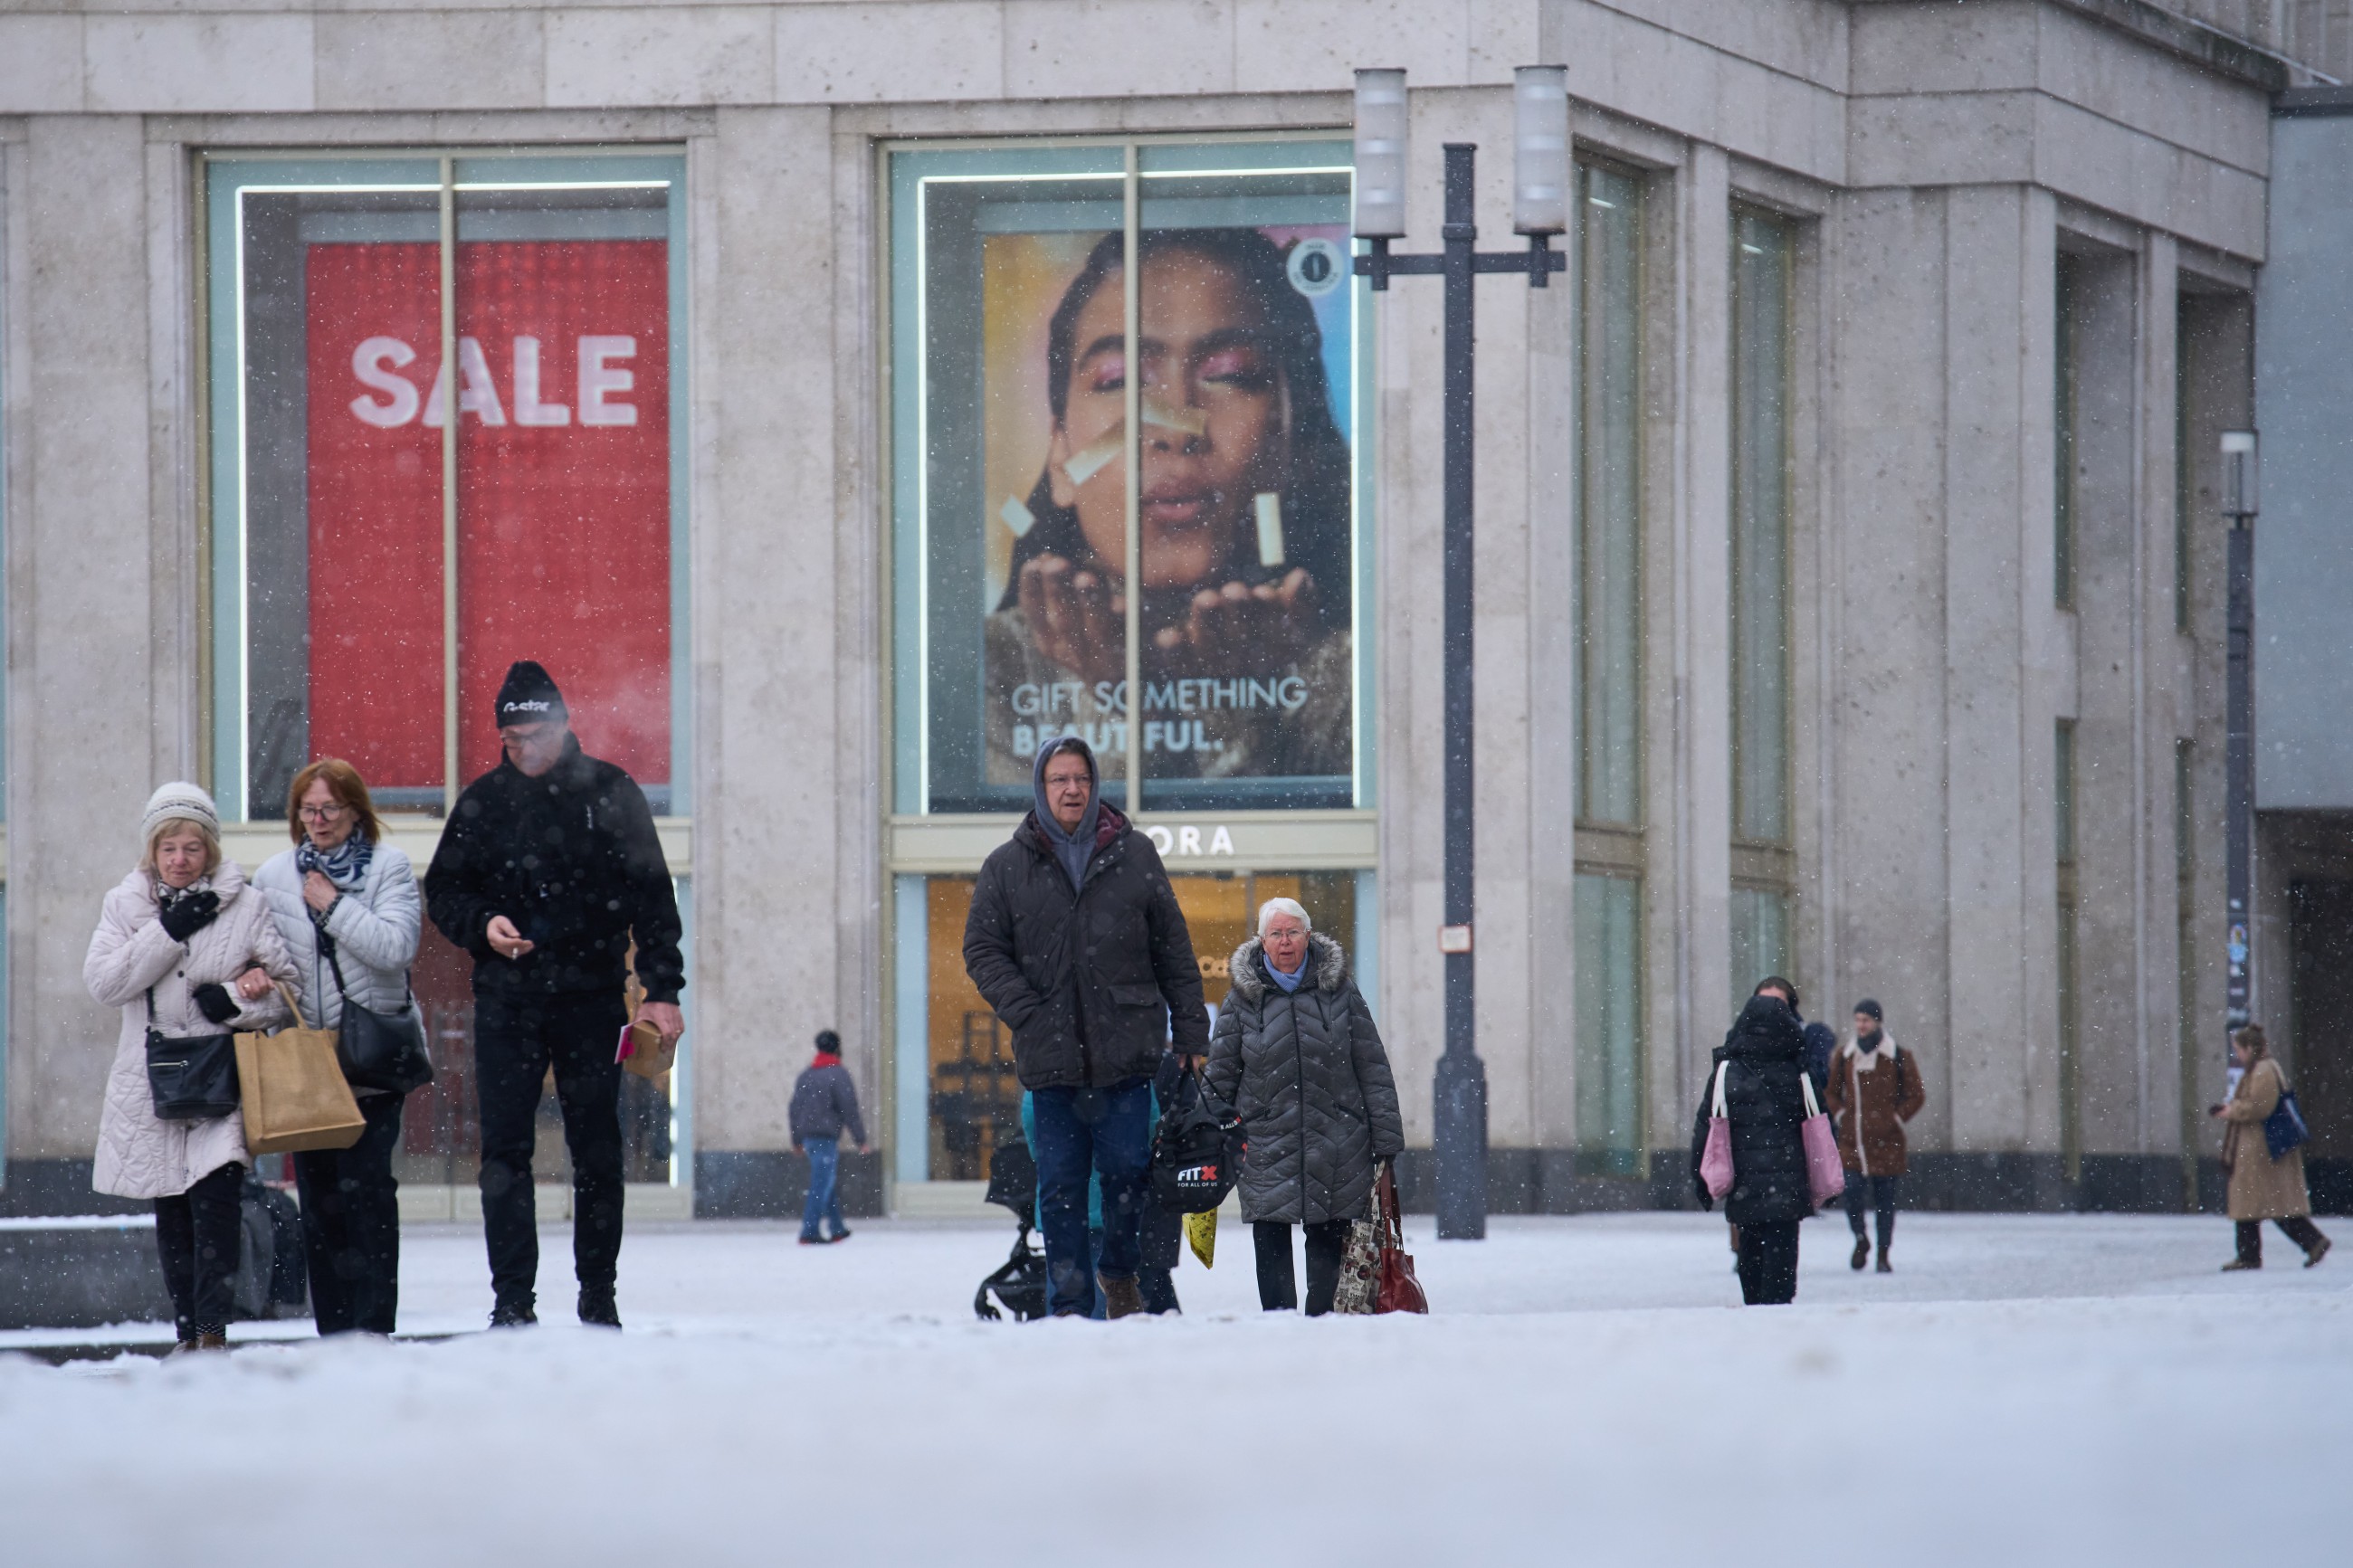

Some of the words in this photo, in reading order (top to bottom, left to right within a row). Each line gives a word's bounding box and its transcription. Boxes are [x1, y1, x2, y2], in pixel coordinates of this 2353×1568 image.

[349, 336, 637, 428] SALE
[1012, 681, 1083, 716] GIFT
[1094, 676, 1308, 714] SOMETHING
[1177, 1165, 1217, 1181] FITX
